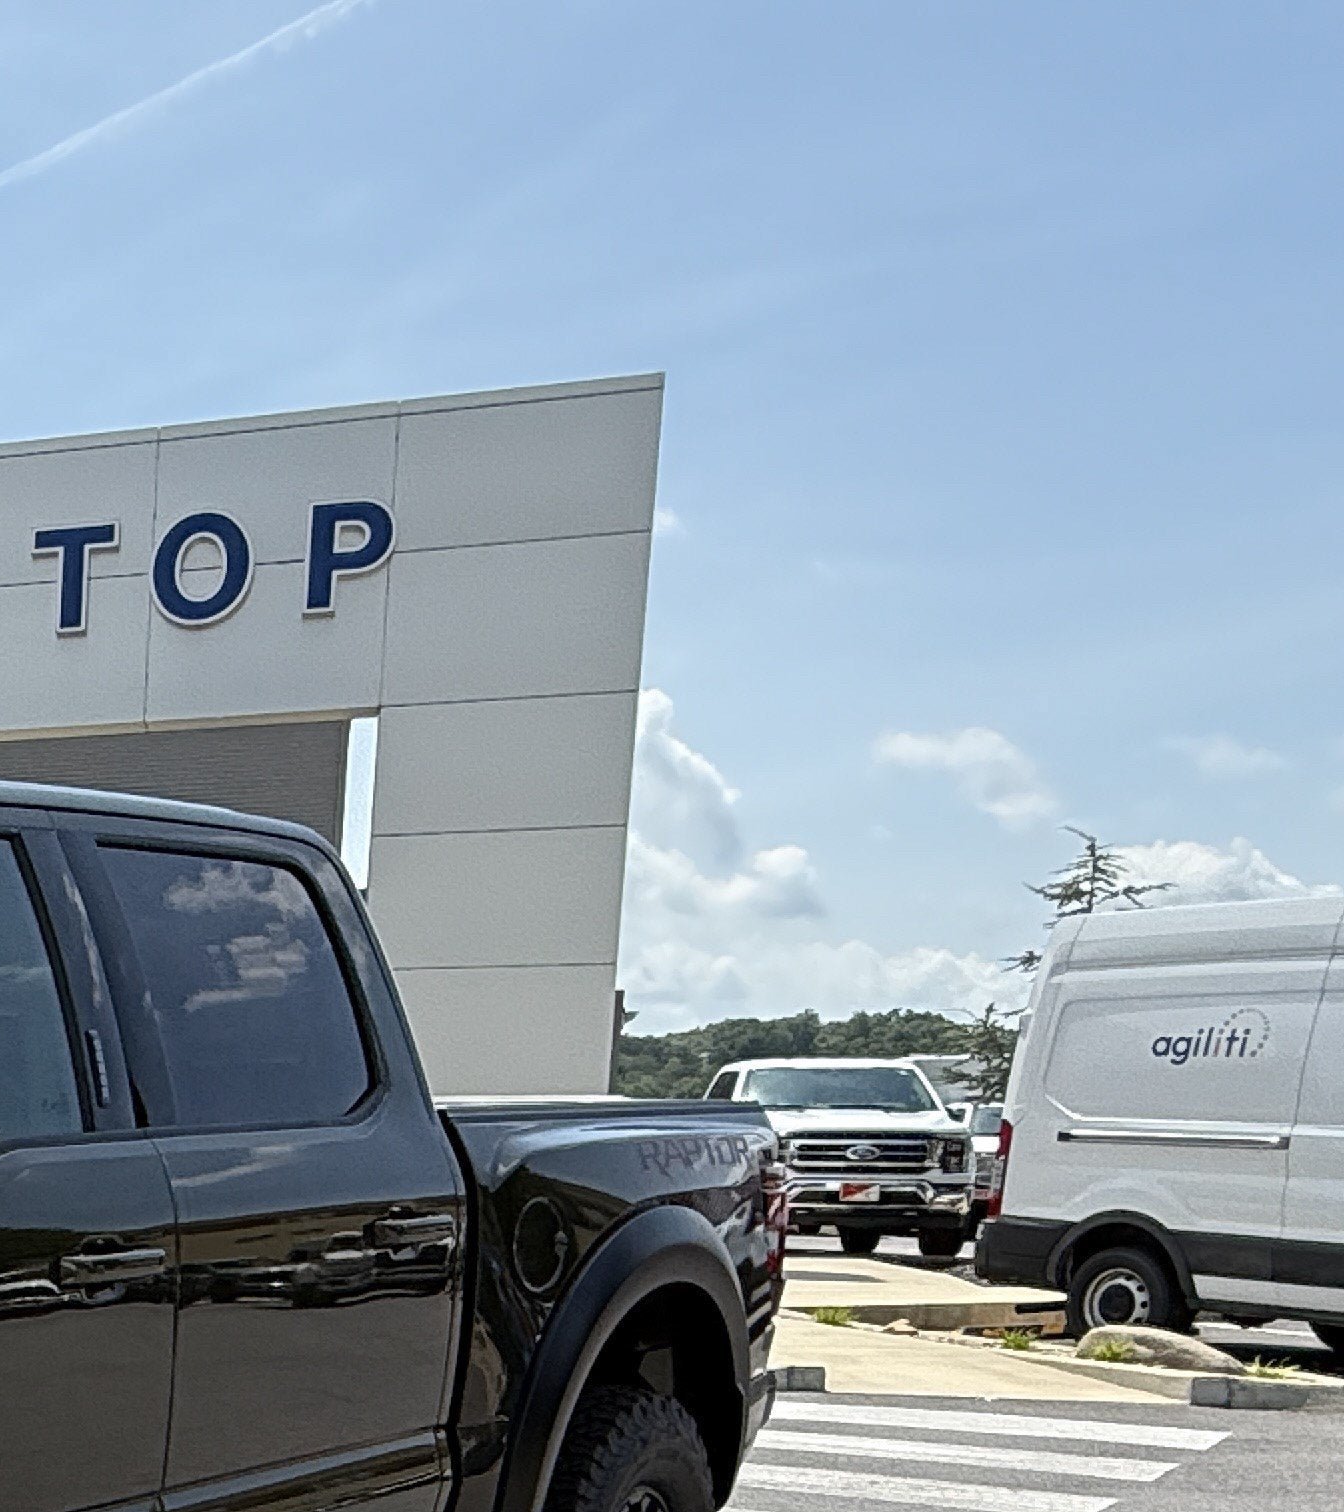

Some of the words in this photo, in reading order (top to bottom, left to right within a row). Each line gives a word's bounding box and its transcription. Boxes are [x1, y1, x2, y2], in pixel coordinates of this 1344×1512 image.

[34, 499, 395, 631] TOP
[1151, 1026, 1251, 1066] agiliti
[638, 1136, 751, 1175] RAPTOR
